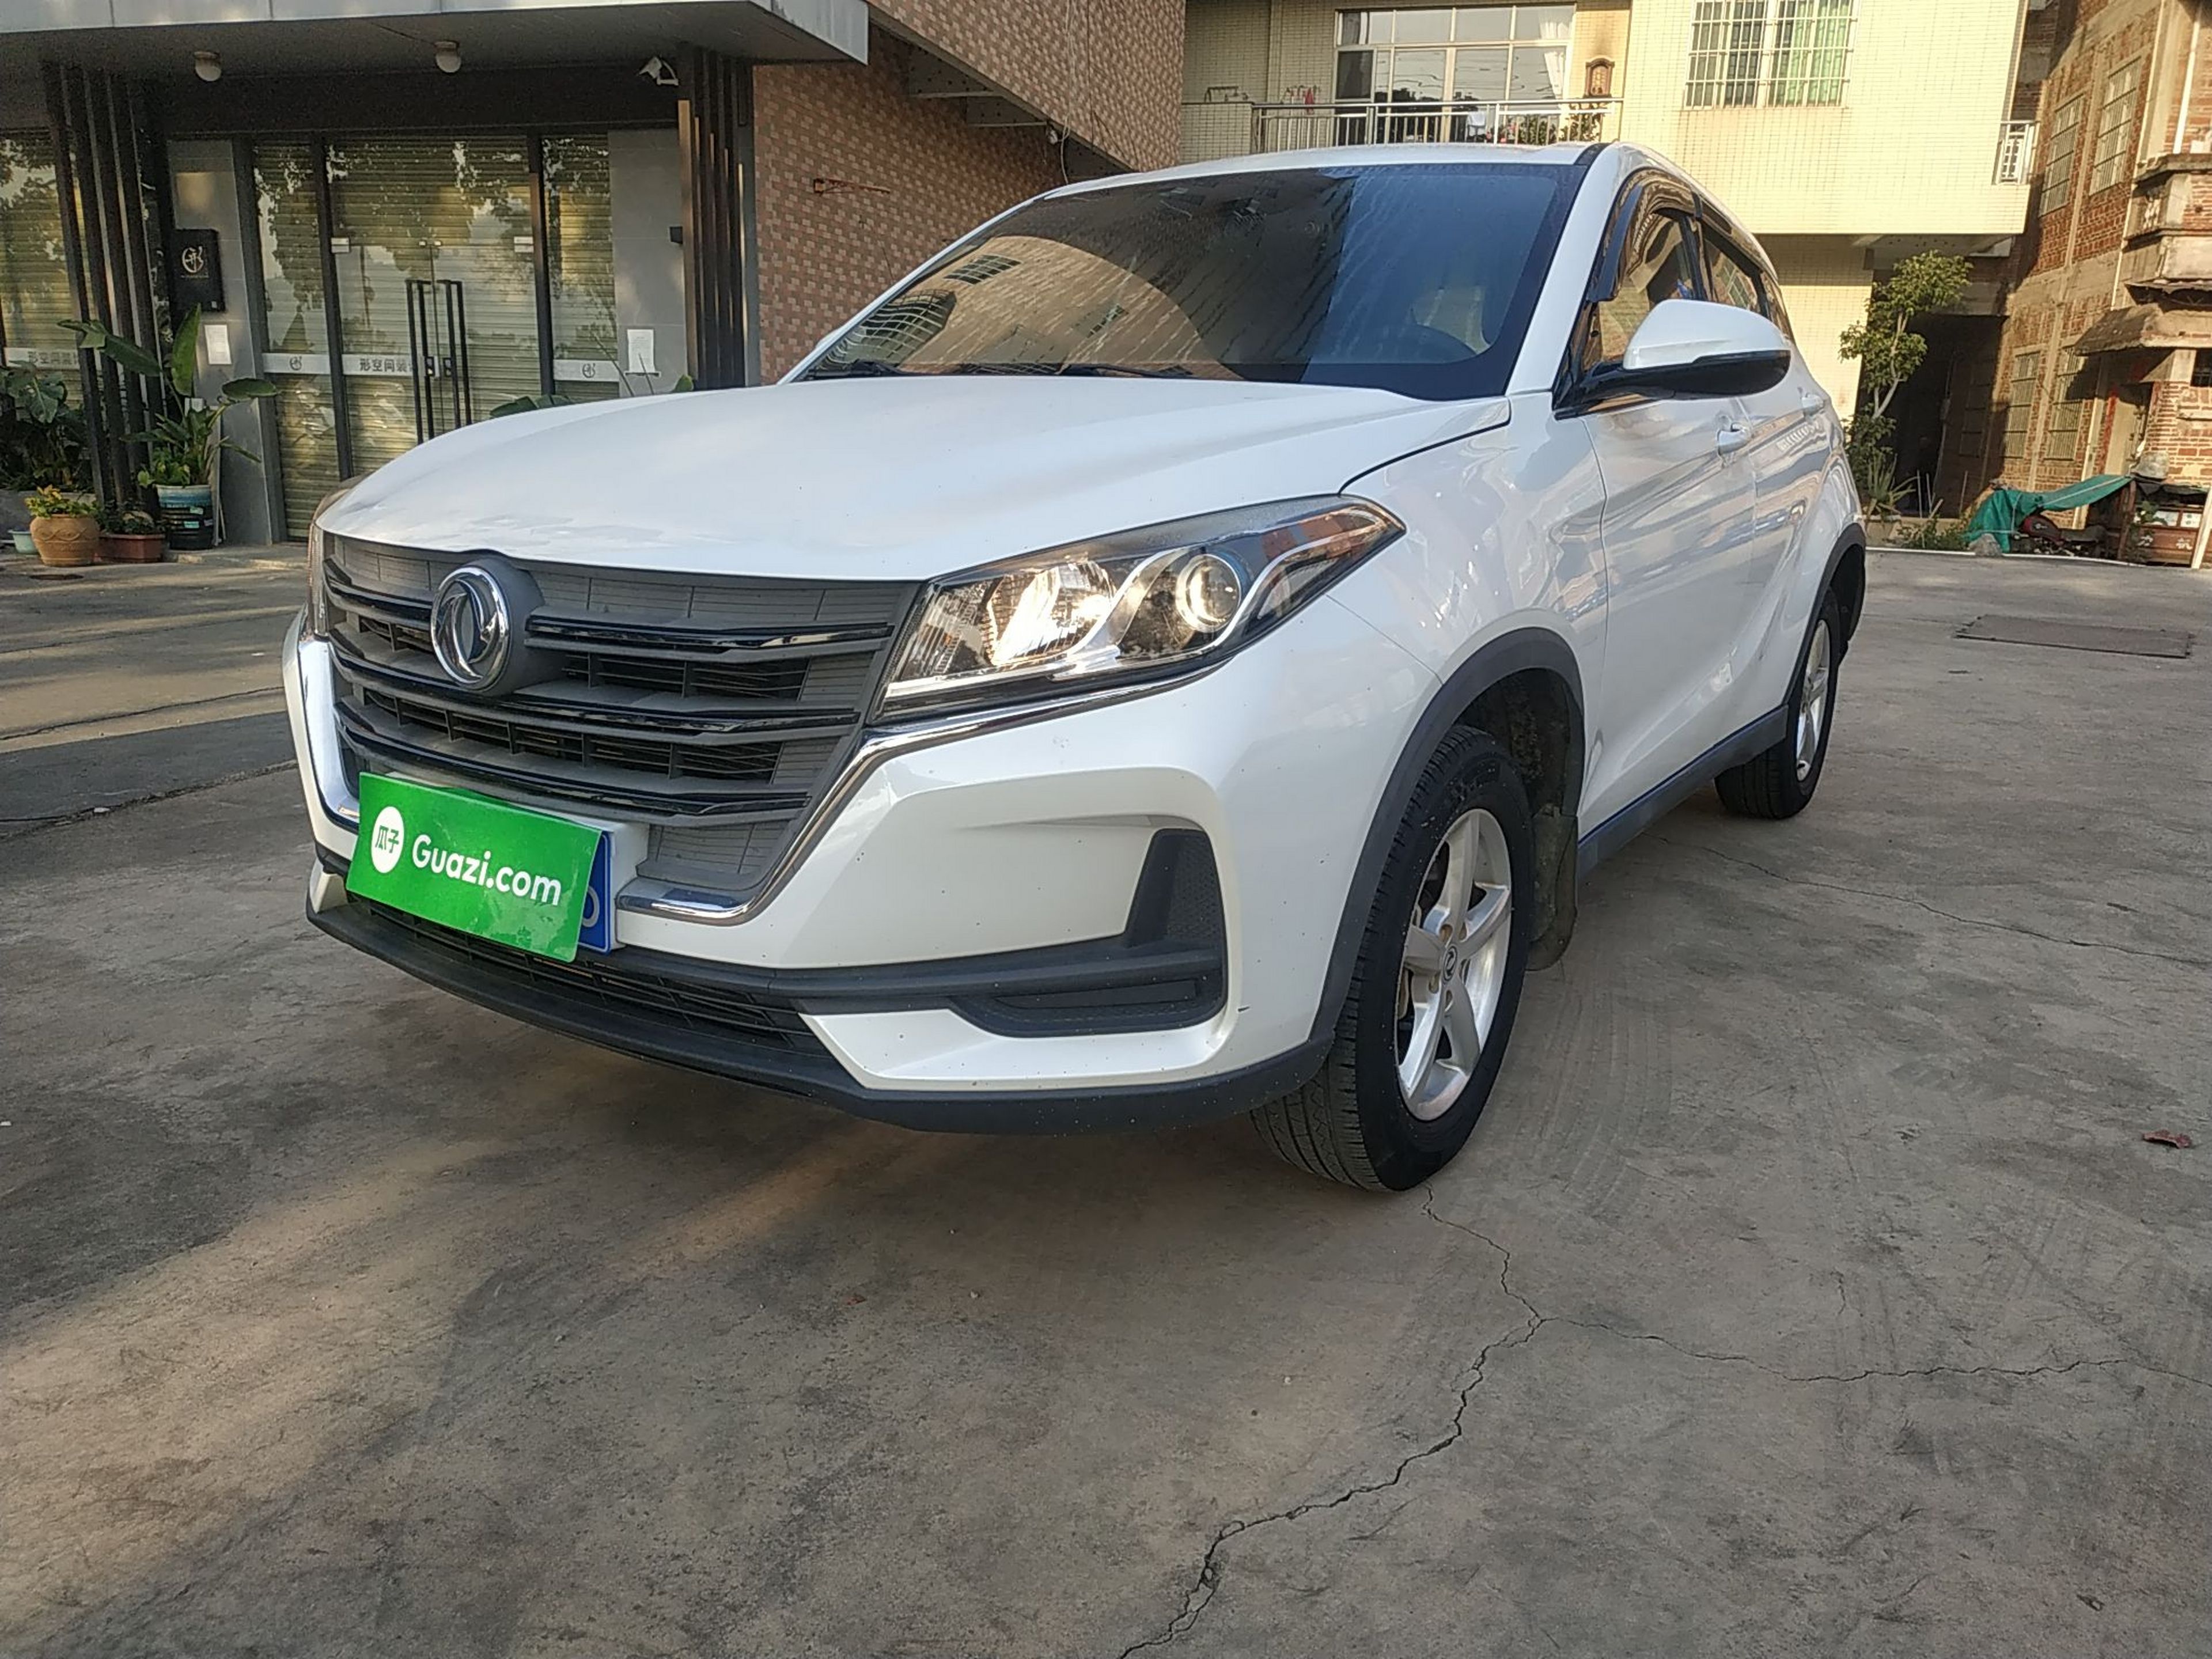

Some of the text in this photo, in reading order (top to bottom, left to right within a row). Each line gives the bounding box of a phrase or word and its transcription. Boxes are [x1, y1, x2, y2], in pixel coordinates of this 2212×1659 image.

[359, 358, 412, 373] 形空间装
[374, 824, 400, 854] 瓜子
[412, 834, 562, 906] Guazi.com
